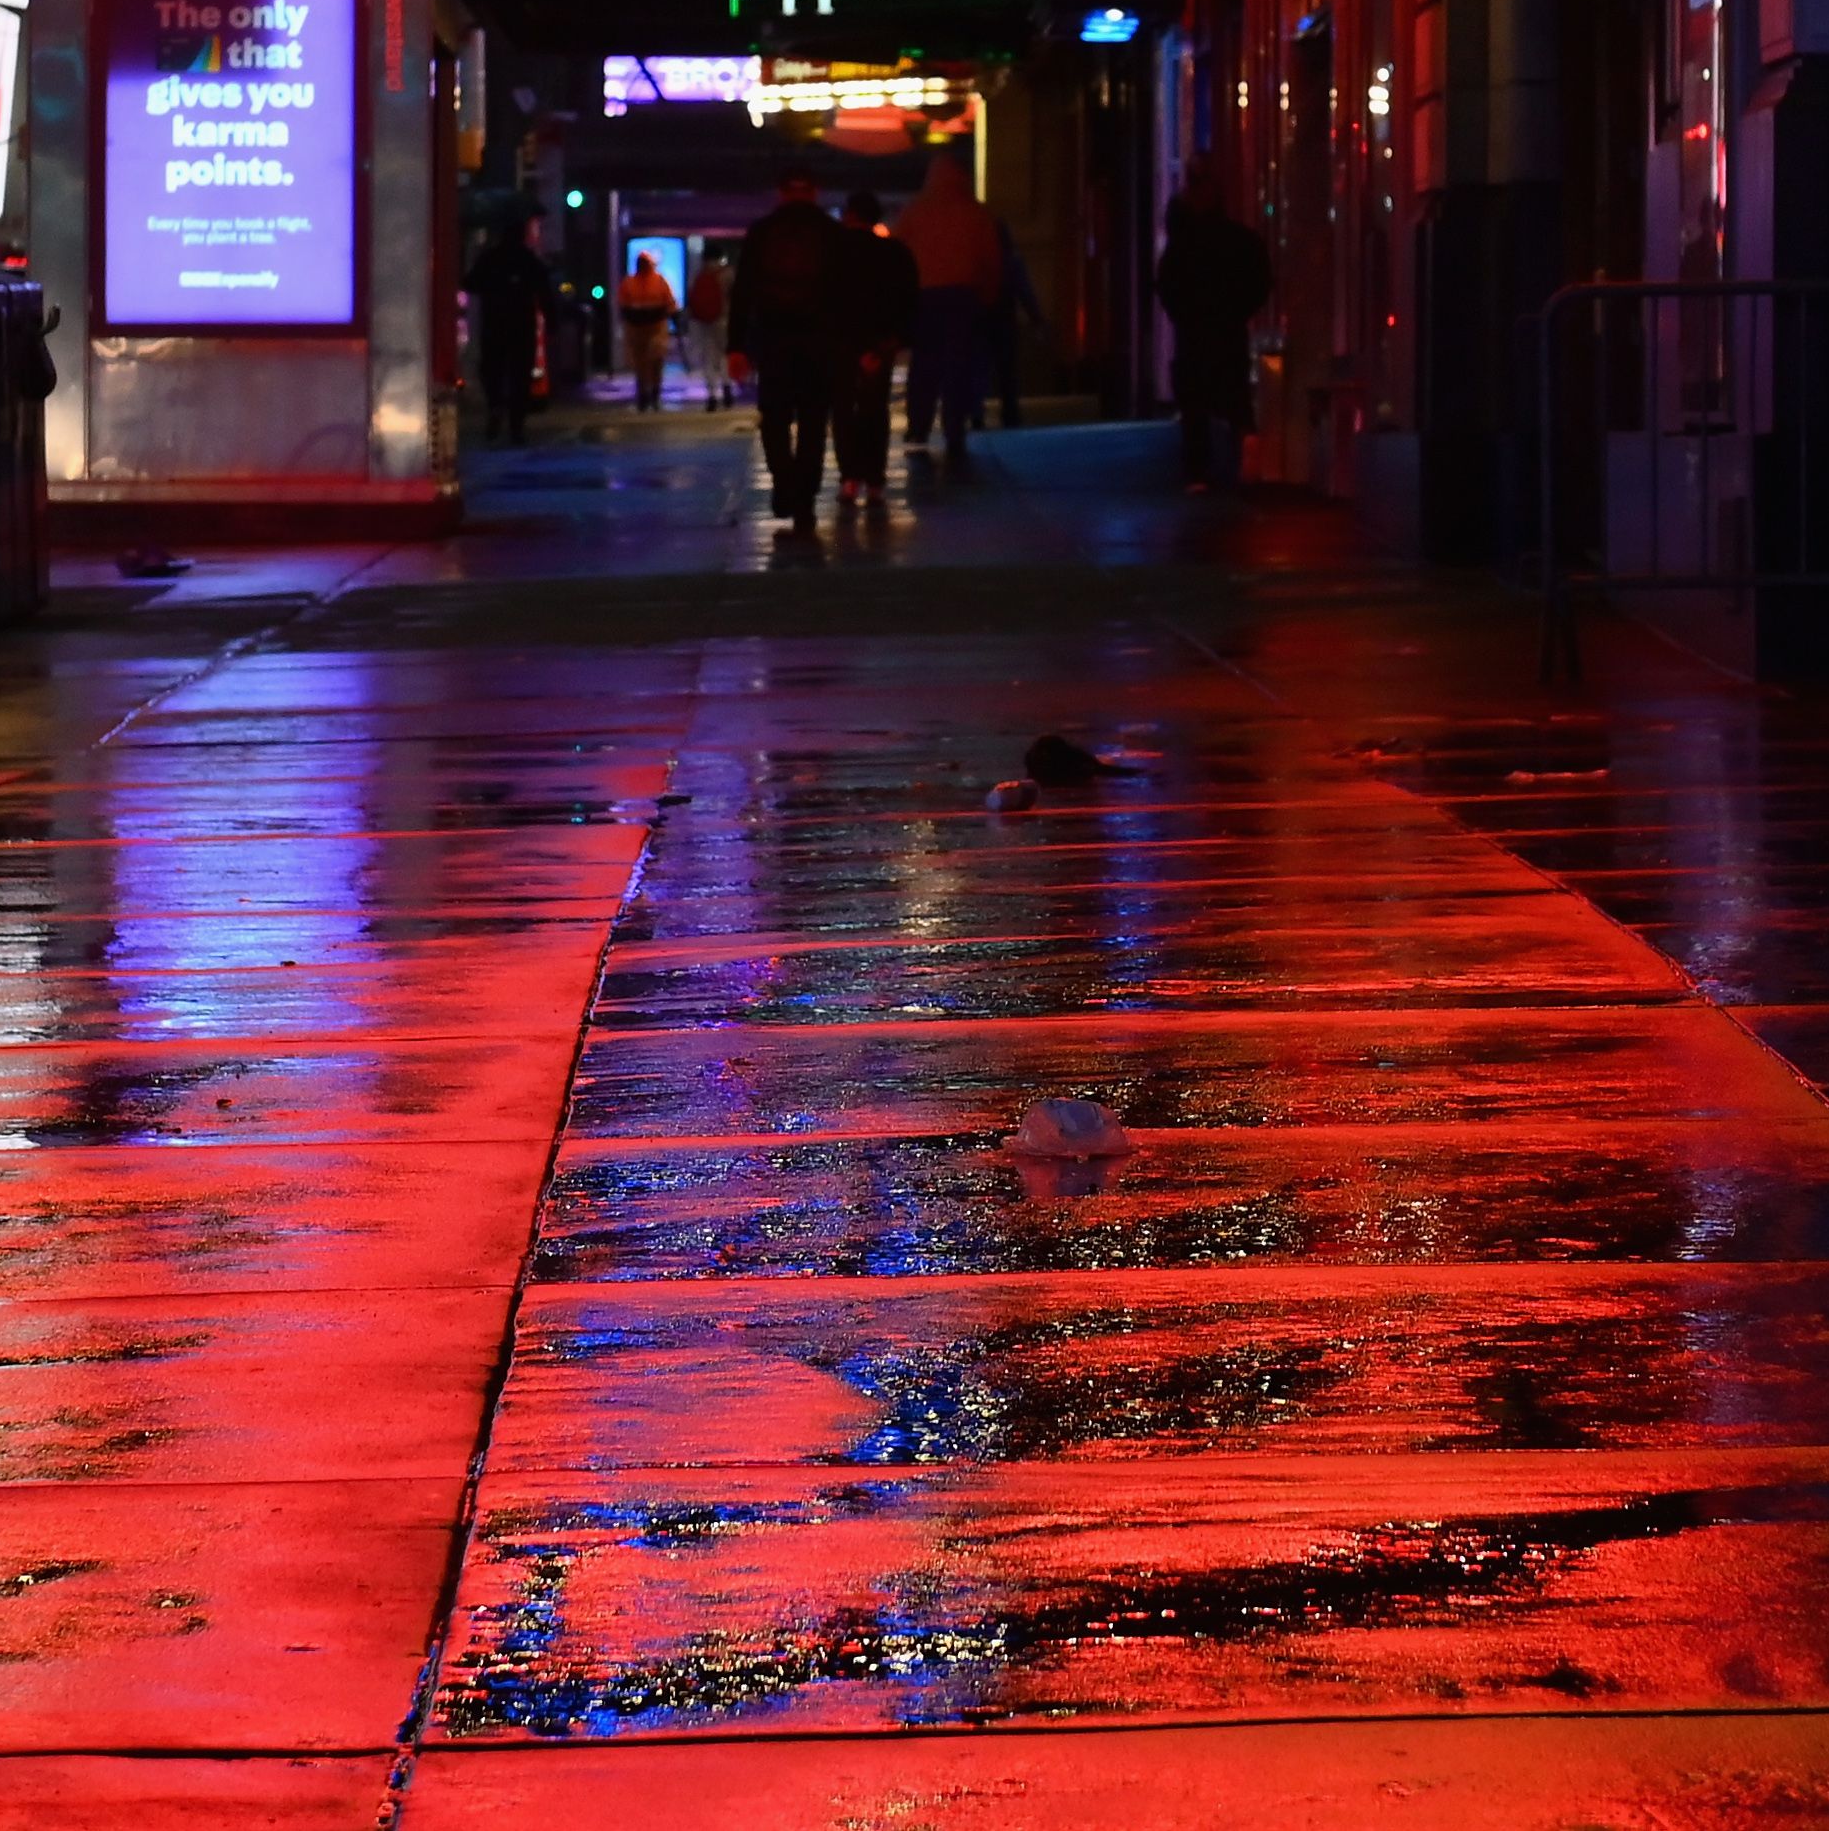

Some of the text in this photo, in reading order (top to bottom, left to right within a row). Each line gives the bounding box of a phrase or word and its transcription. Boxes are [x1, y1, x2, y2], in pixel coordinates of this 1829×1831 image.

[156, 0, 222, 29] The
[228, 38, 304, 70] that
[146, 74, 315, 116] gives you
[172, 114, 289, 148] karma
[165, 152, 295, 193] points.
